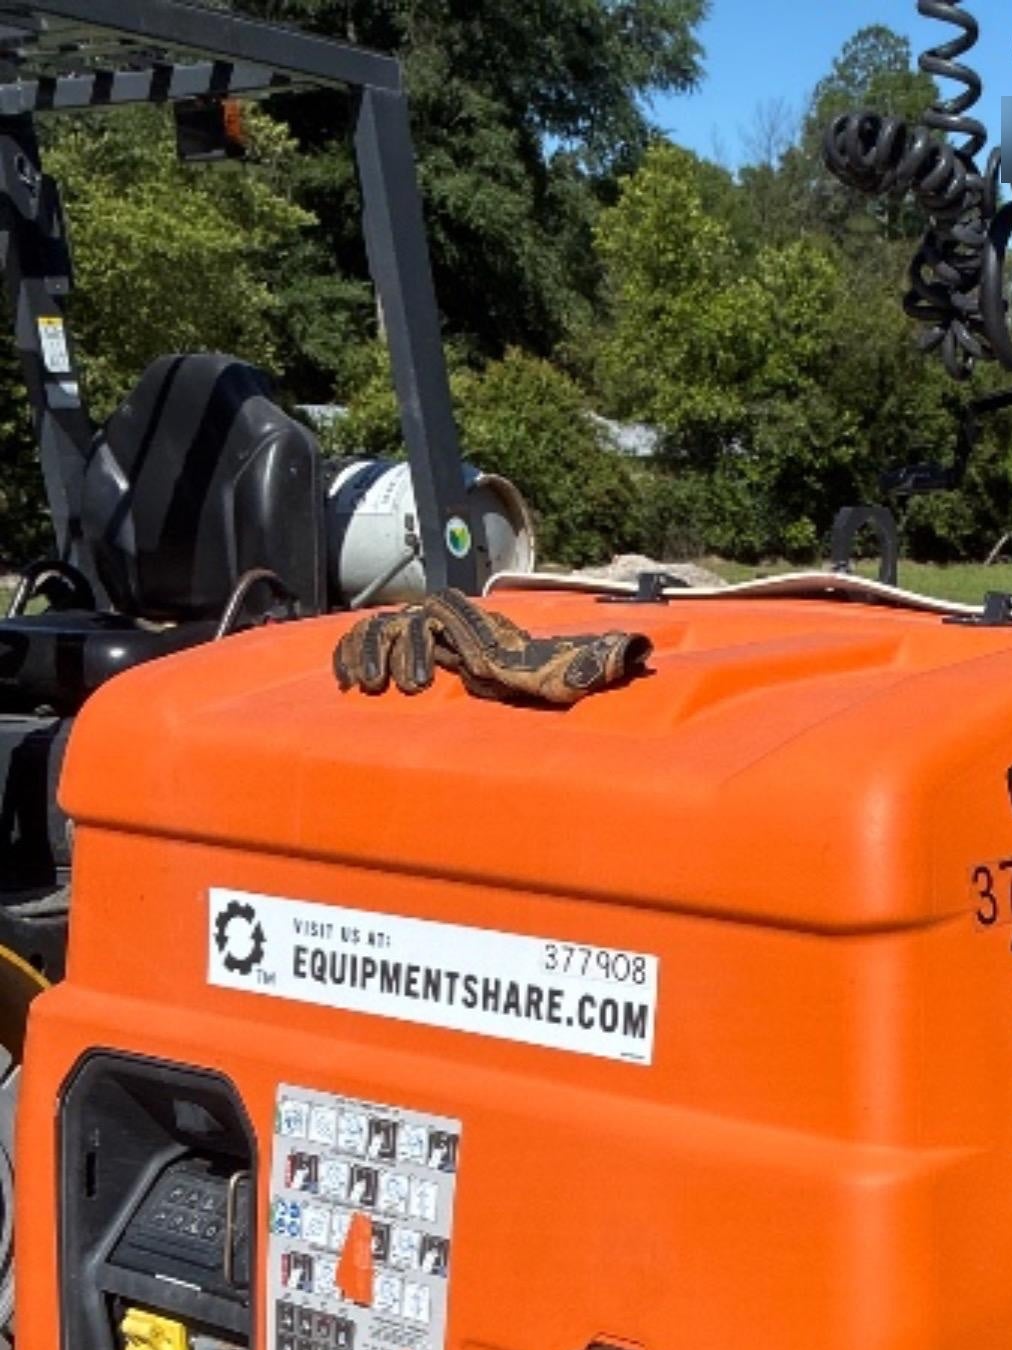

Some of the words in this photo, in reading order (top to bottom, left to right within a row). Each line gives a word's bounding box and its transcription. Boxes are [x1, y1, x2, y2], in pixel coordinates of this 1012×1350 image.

[293, 918, 334, 940] VISIT
[341, 926, 361, 944] US
[543, 944, 647, 985] 377908
[293, 945, 649, 1039] EQUIPMENTSHARE.COM
